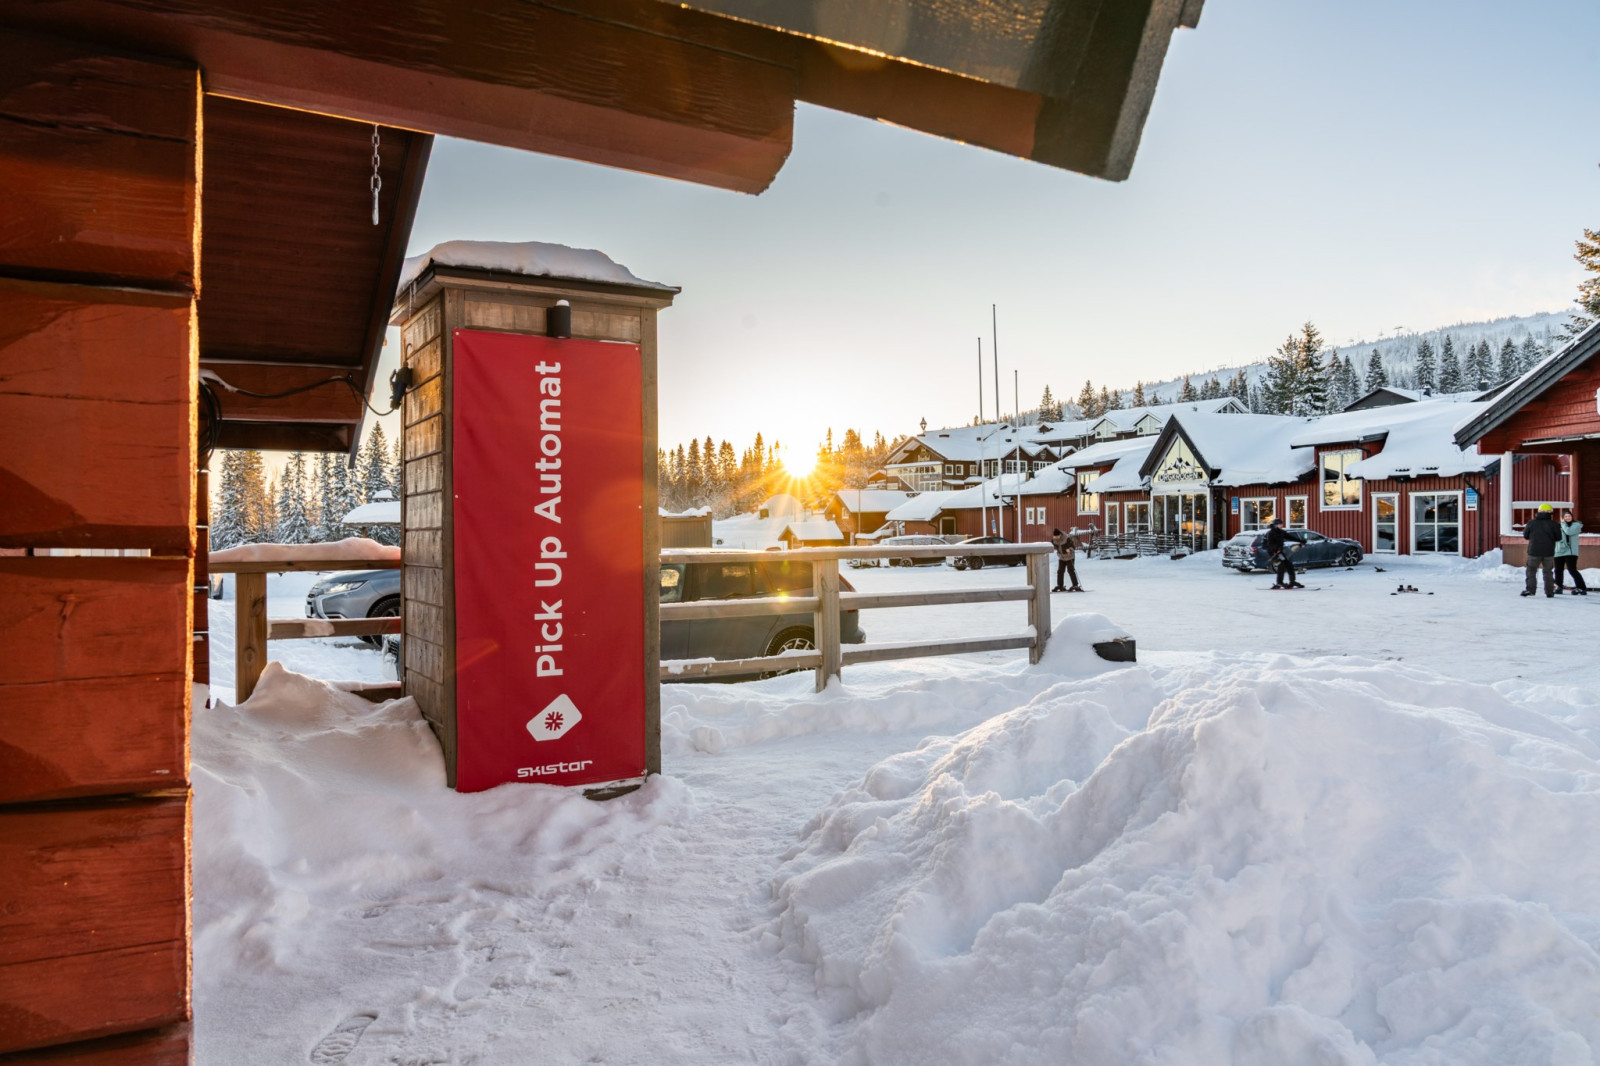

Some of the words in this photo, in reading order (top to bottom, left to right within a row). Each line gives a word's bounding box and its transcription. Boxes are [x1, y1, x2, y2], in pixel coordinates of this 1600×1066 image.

[534, 360, 562, 524] Automat
[534, 536, 568, 587] Up
[534, 599, 563, 677] Pick
